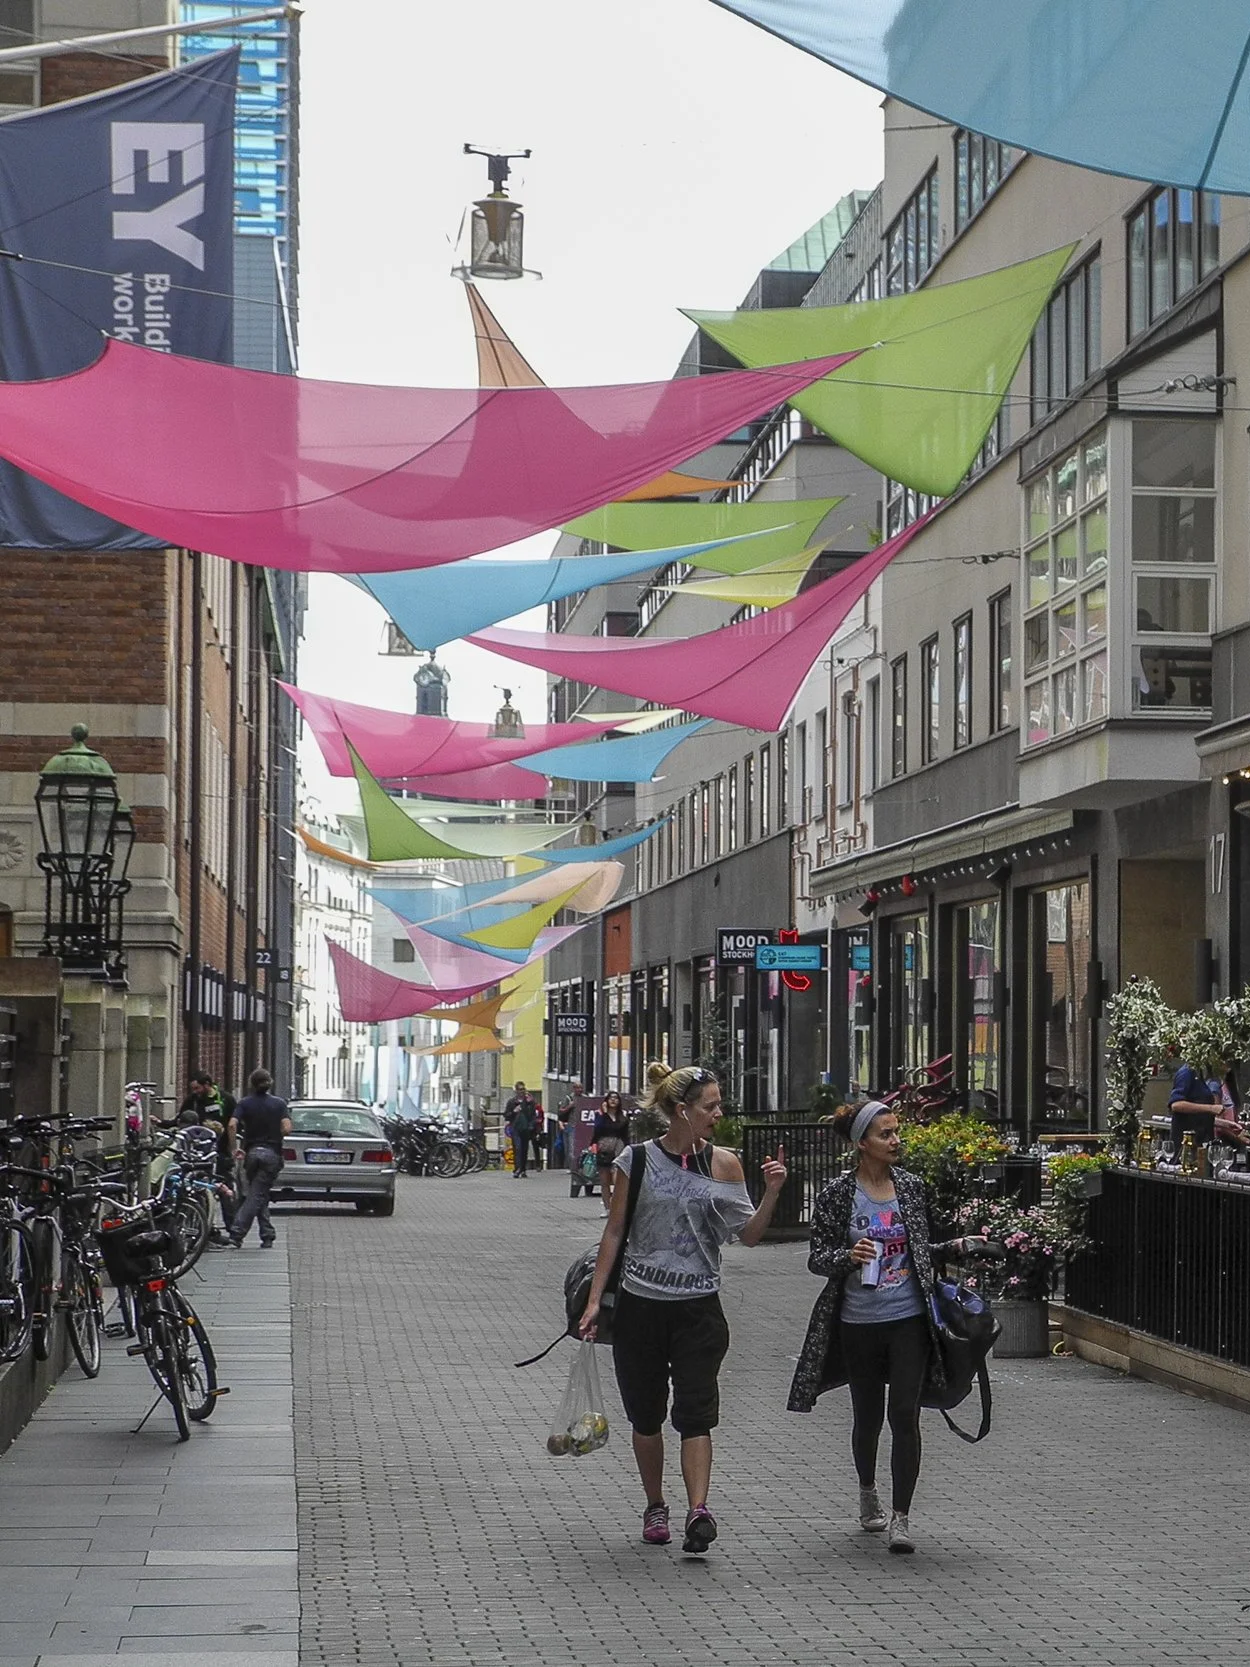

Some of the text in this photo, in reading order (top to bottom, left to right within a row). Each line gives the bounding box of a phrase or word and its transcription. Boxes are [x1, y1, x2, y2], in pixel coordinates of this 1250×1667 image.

[111, 122, 205, 272] EY
[113, 272, 141, 342] work
[1209, 832, 1225, 894] 17
[721, 935, 769, 951] MOOD
[256, 952, 272, 964] 22
[721, 950, 755, 959] STOCKH
[557, 1017, 587, 1028] MOOD
